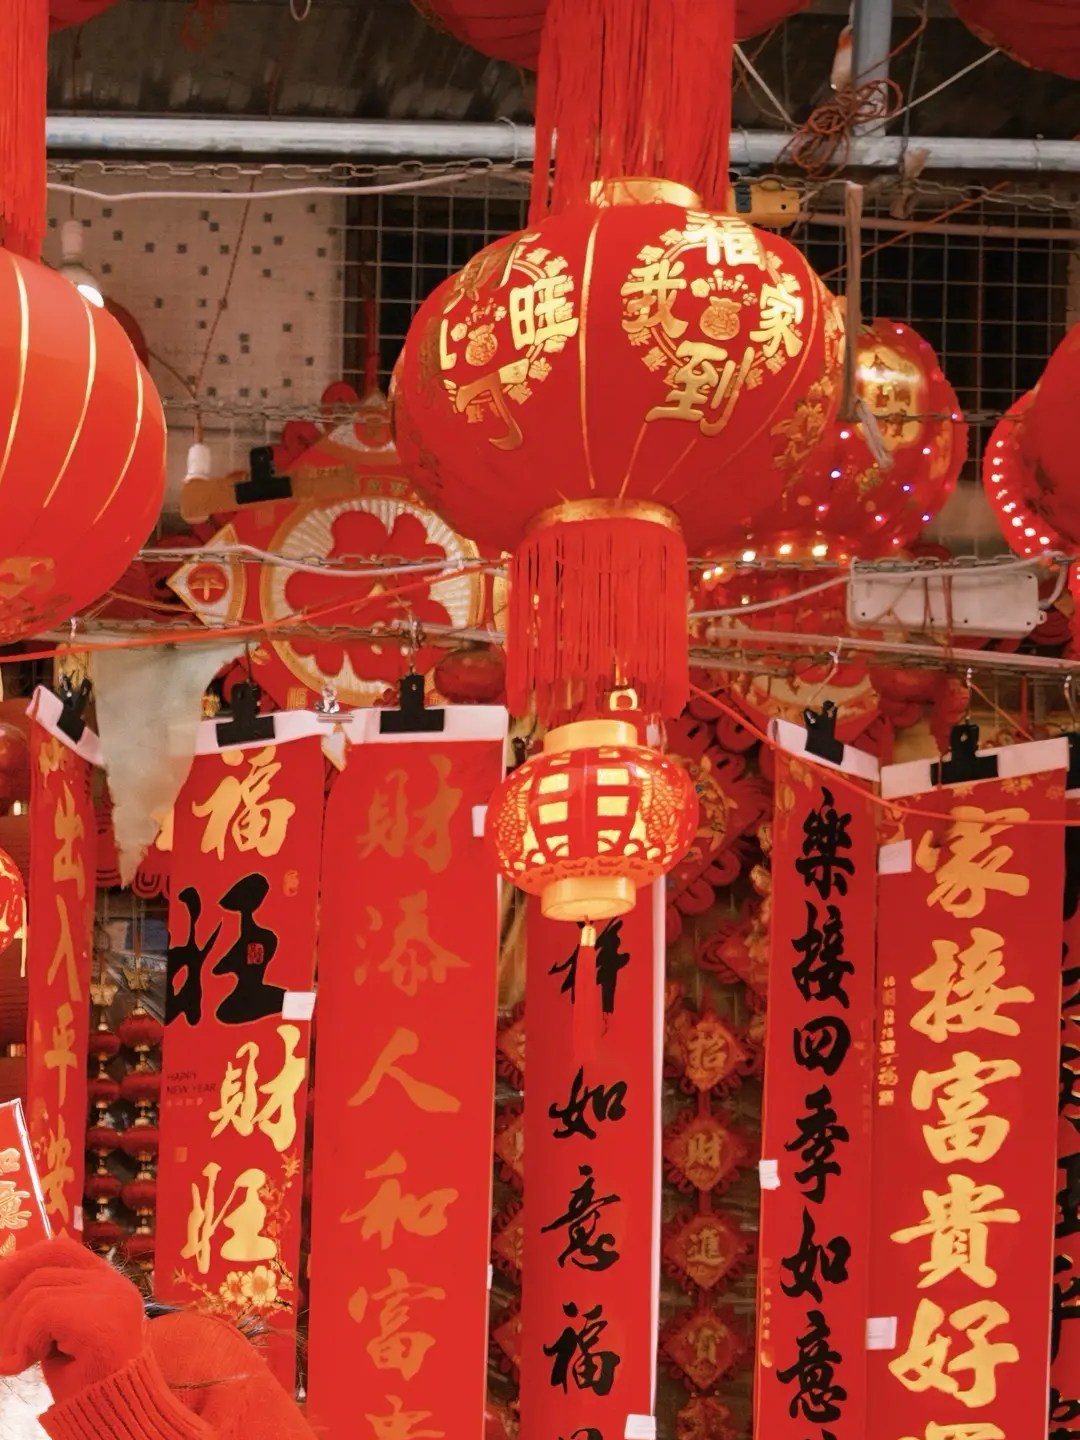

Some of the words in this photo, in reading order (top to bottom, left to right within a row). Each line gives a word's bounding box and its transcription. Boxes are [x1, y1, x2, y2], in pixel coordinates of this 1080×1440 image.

[40, 780, 86, 1240] 出入平安
[165, 746, 306, 1274] 福旺財旺
